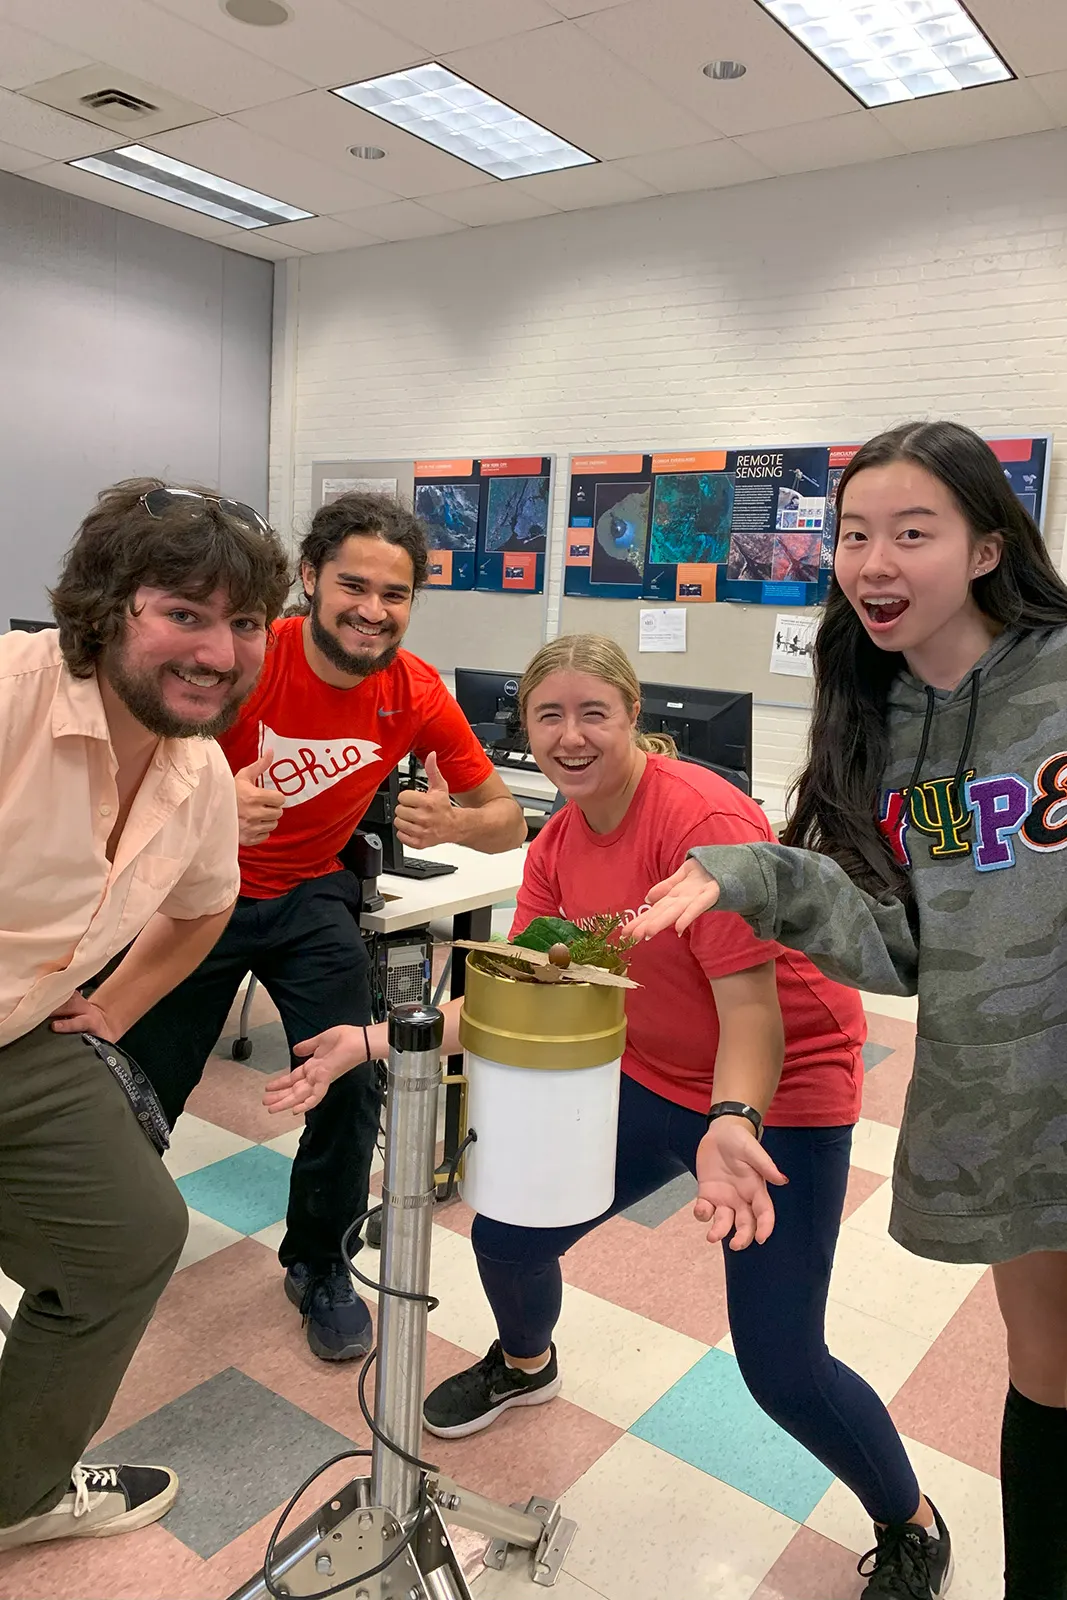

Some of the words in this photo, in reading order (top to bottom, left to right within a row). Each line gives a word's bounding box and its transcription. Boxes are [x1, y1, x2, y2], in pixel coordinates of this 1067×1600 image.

[736, 454, 784, 467] REMOTE
[735, 466, 783, 478] SENSING
[269, 745, 361, 796] Ohio
